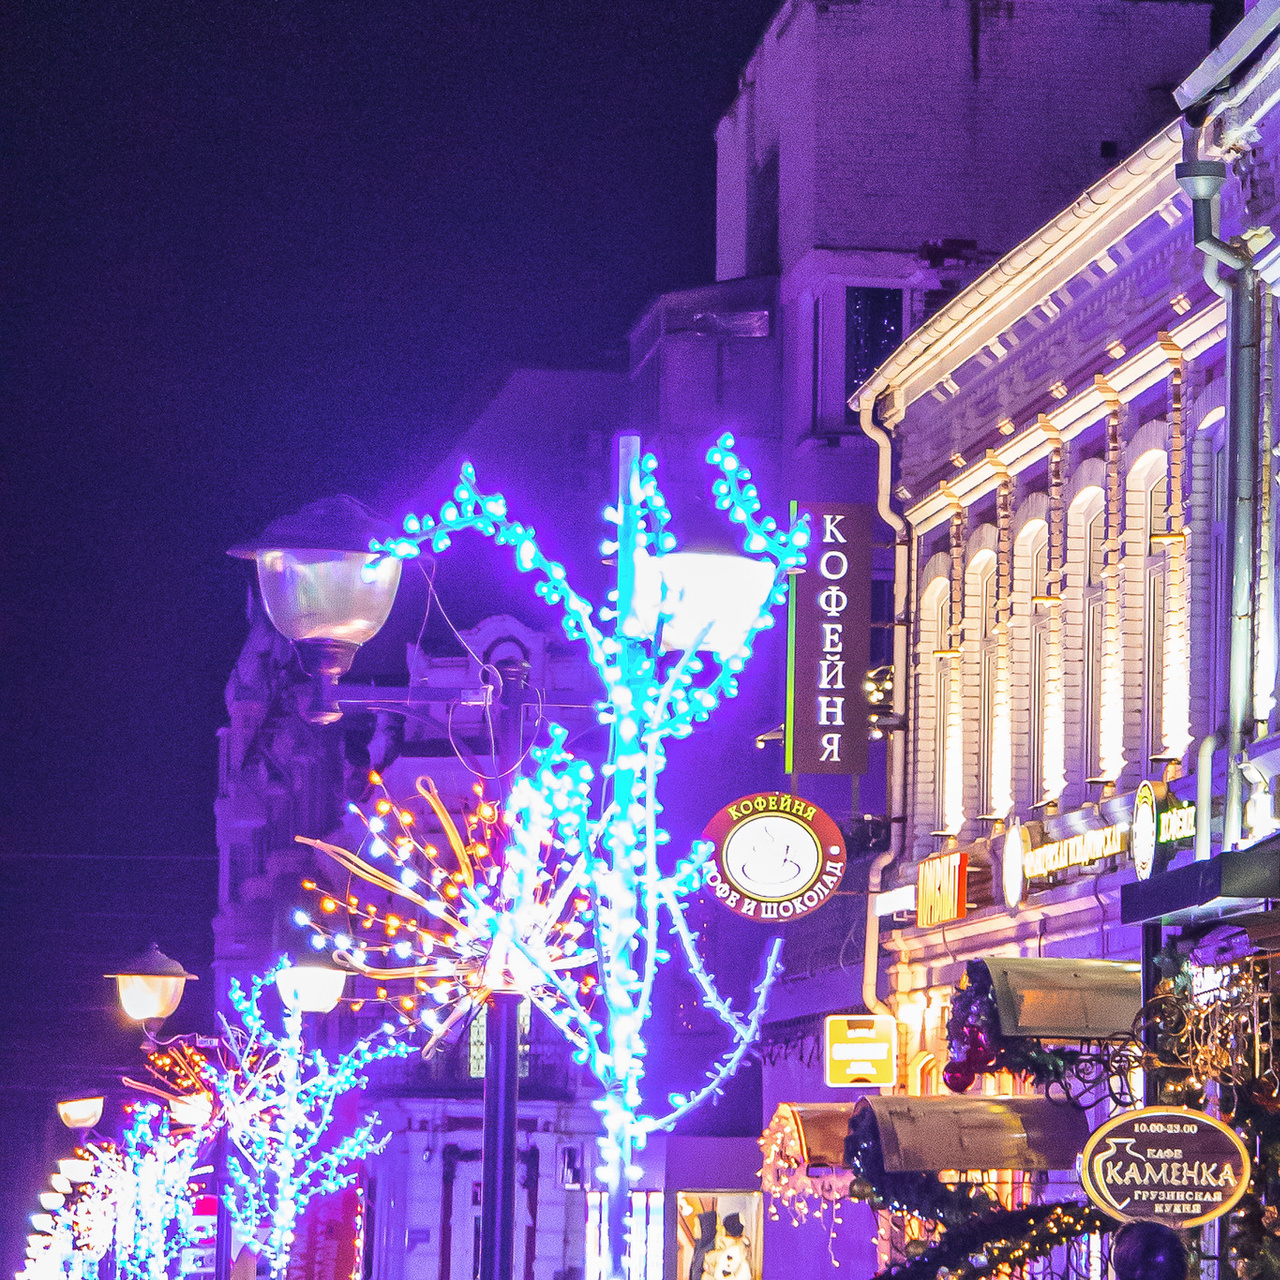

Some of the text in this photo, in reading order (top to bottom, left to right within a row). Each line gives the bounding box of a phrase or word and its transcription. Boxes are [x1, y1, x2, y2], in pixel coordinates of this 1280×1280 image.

[818, 513, 849, 762] КОФЕЙНЯ
[727, 794, 817, 821] КОФЕЙНЯ
[741, 898, 758, 917] И
[760, 860, 844, 919] ШОКОЛАД
[1147, 1148, 1183, 1159] КАФЕ
[1106, 1160, 1238, 1187] КАМЕНКА
[1133, 1189, 1223, 1201] ГРУЗИНСКАЯ
[1154, 1203, 1202, 1214] КУХНЯ
